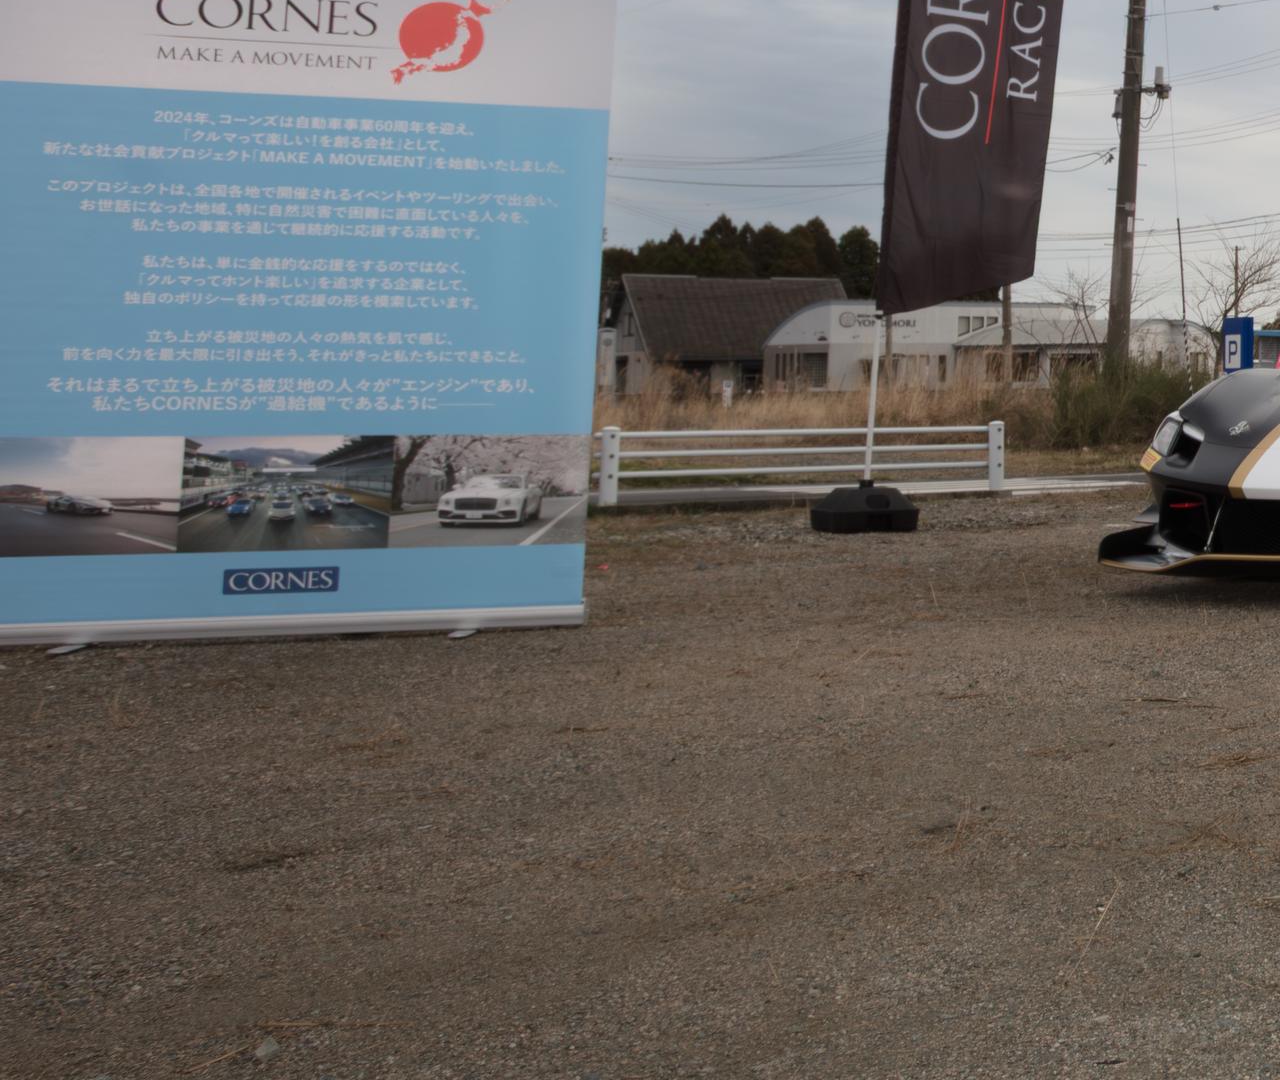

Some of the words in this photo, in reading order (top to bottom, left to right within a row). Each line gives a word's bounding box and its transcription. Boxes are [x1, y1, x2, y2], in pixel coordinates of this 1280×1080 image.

[156, 45, 223, 64] MAKE
[230, 48, 246, 65] A
[251, 51, 378, 71] MOVEMENT
[1228, 340, 1238, 364] P
[229, 569, 335, 593] CORNES
